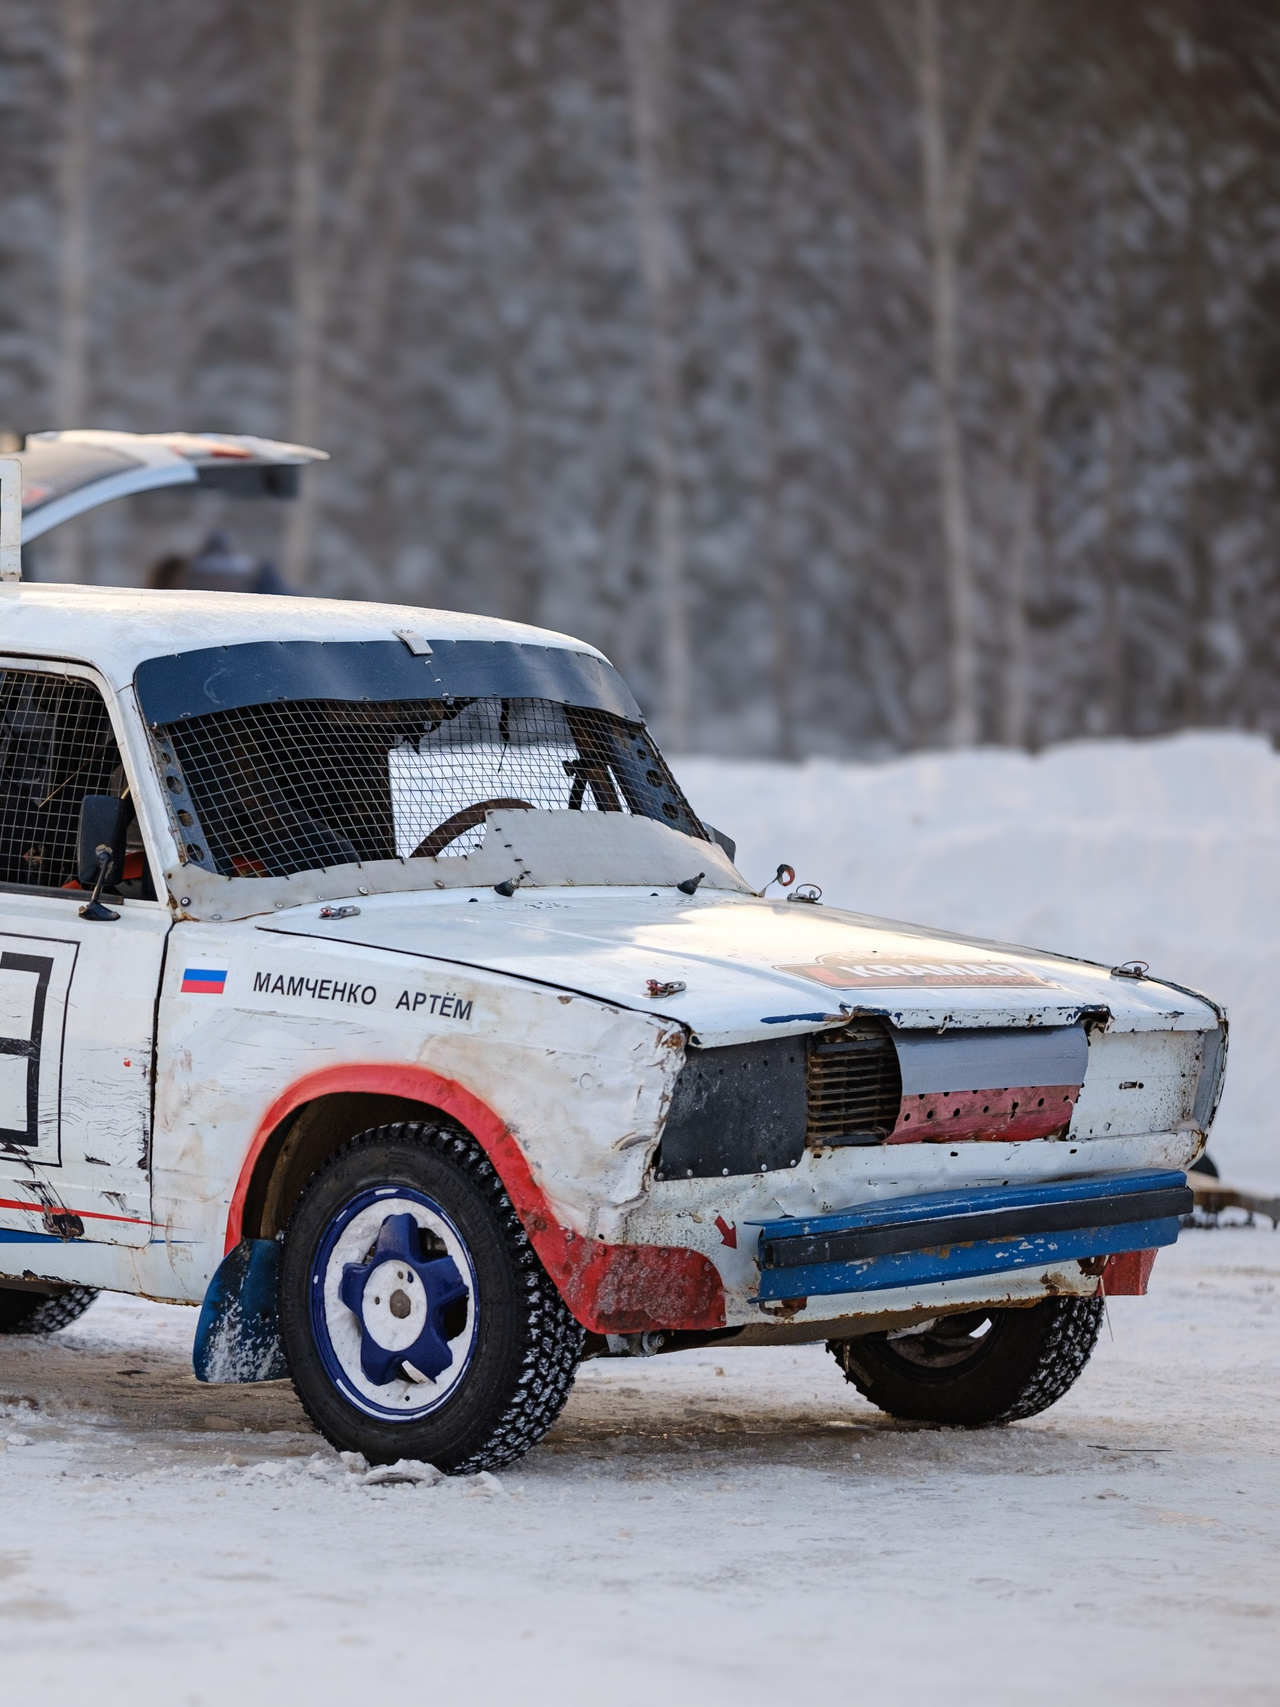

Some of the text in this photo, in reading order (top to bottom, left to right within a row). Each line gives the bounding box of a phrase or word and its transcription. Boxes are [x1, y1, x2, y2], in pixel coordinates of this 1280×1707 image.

[837, 963, 1030, 977] KRAMAR
[253, 971, 474, 1021] МАМЧЕНКО АРТЁМ
